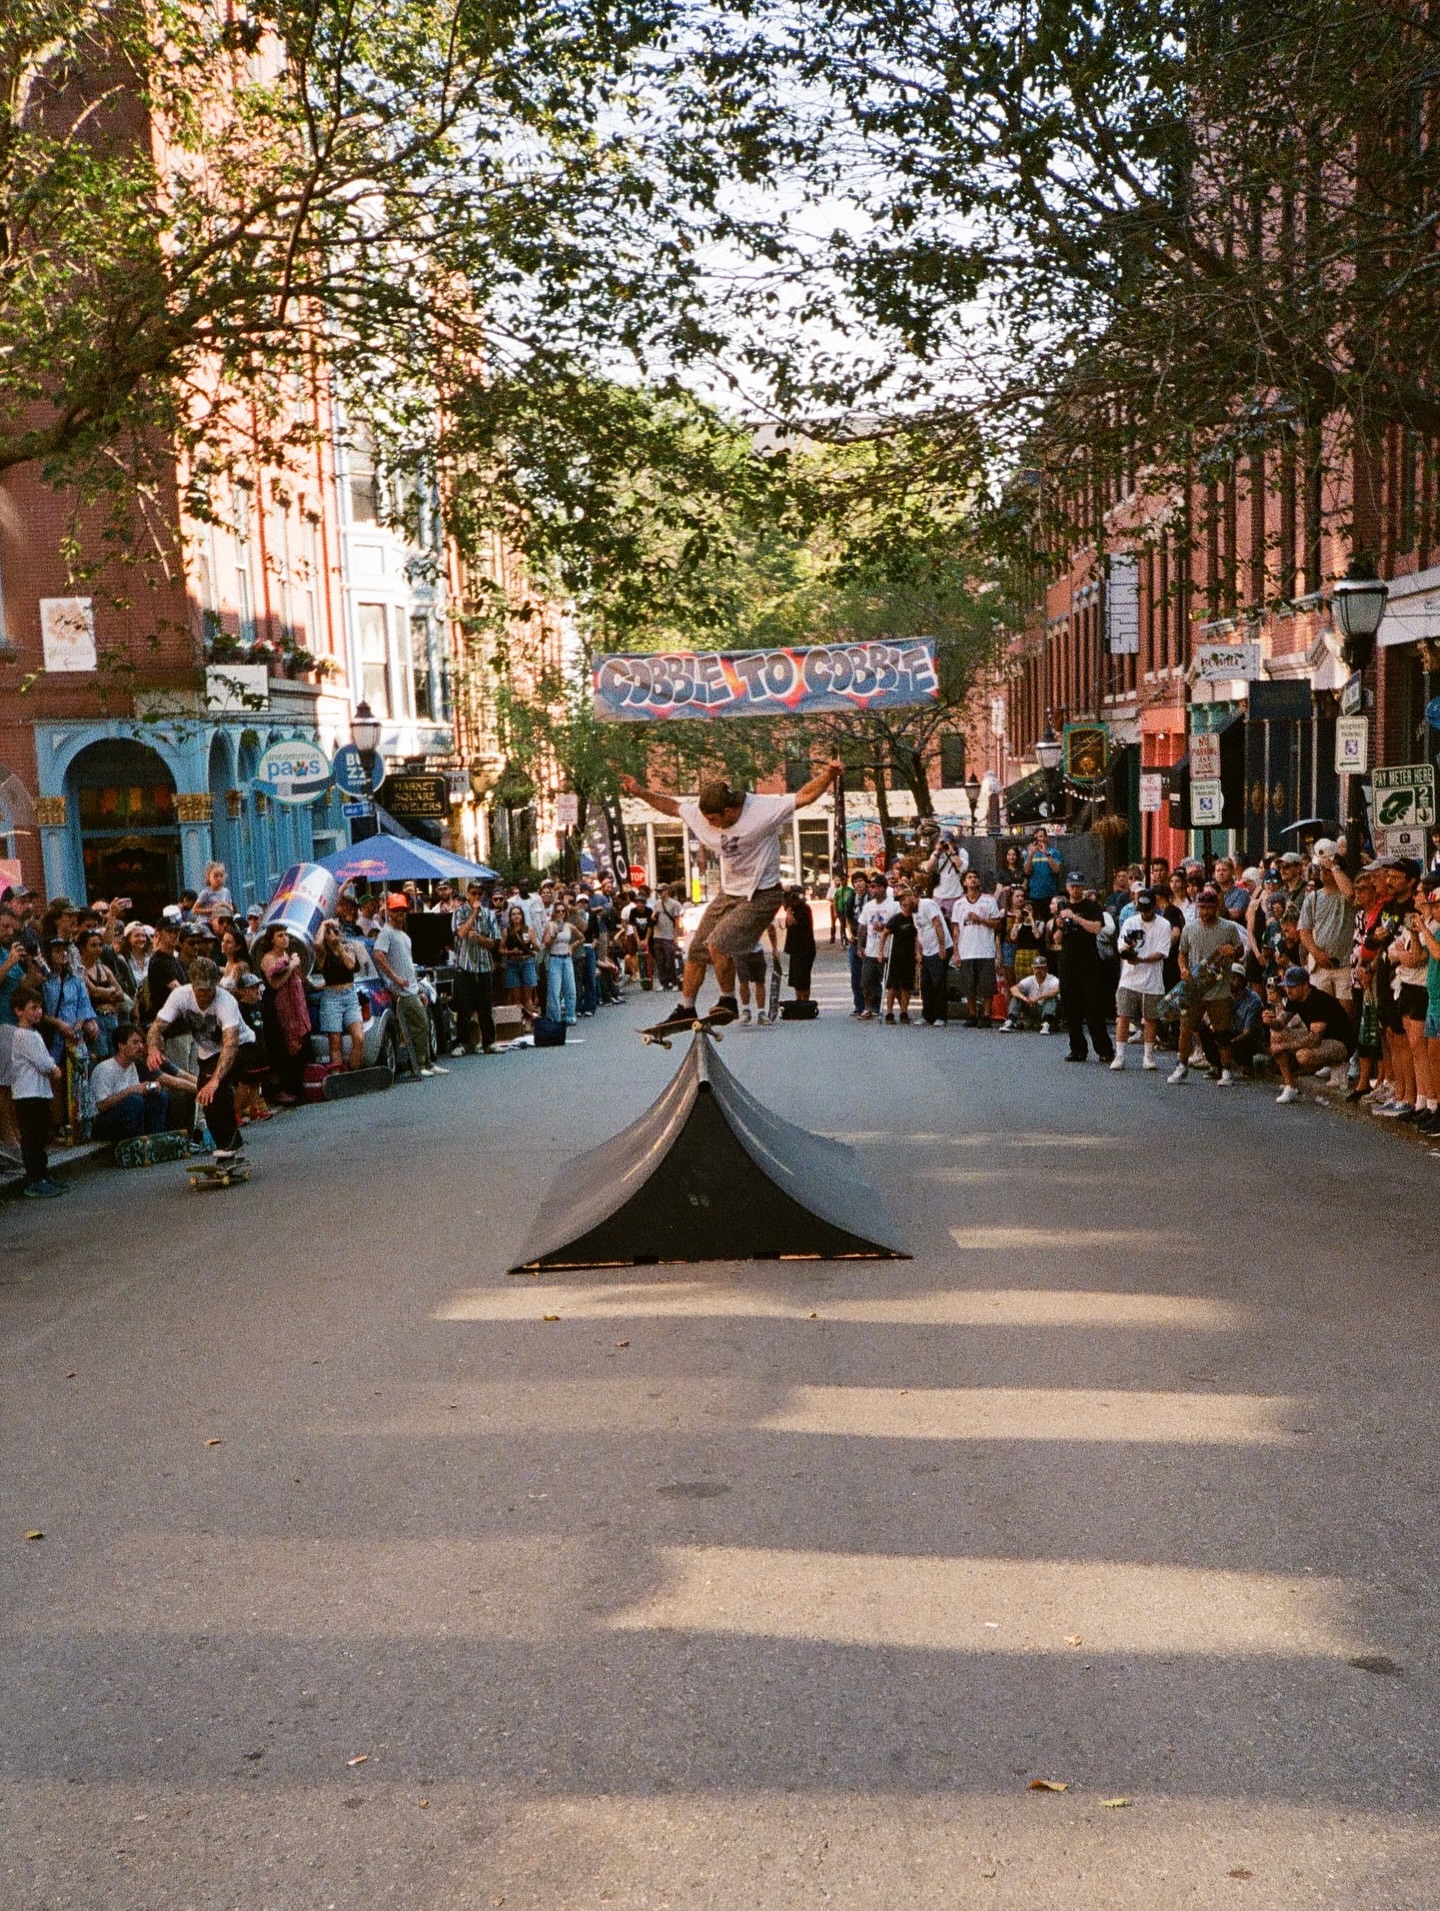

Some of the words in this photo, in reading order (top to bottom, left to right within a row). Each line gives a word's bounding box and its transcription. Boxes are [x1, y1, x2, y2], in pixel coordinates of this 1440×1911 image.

[599, 653, 737, 707] COBBLE
[734, 652, 798, 702] TO
[803, 643, 939, 696] COBBLE
[1374, 771, 1387, 788] PAY
[1389, 769, 1412, 785] METER
[1414, 767, 1433, 783] HERE
[393, 781, 435, 791] MARKET
[394, 791, 436, 801] SQUARE
[1418, 786, 1429, 798] 2
[390, 802, 442, 812] JEWELERS
[630, 872, 645, 881] TOP
